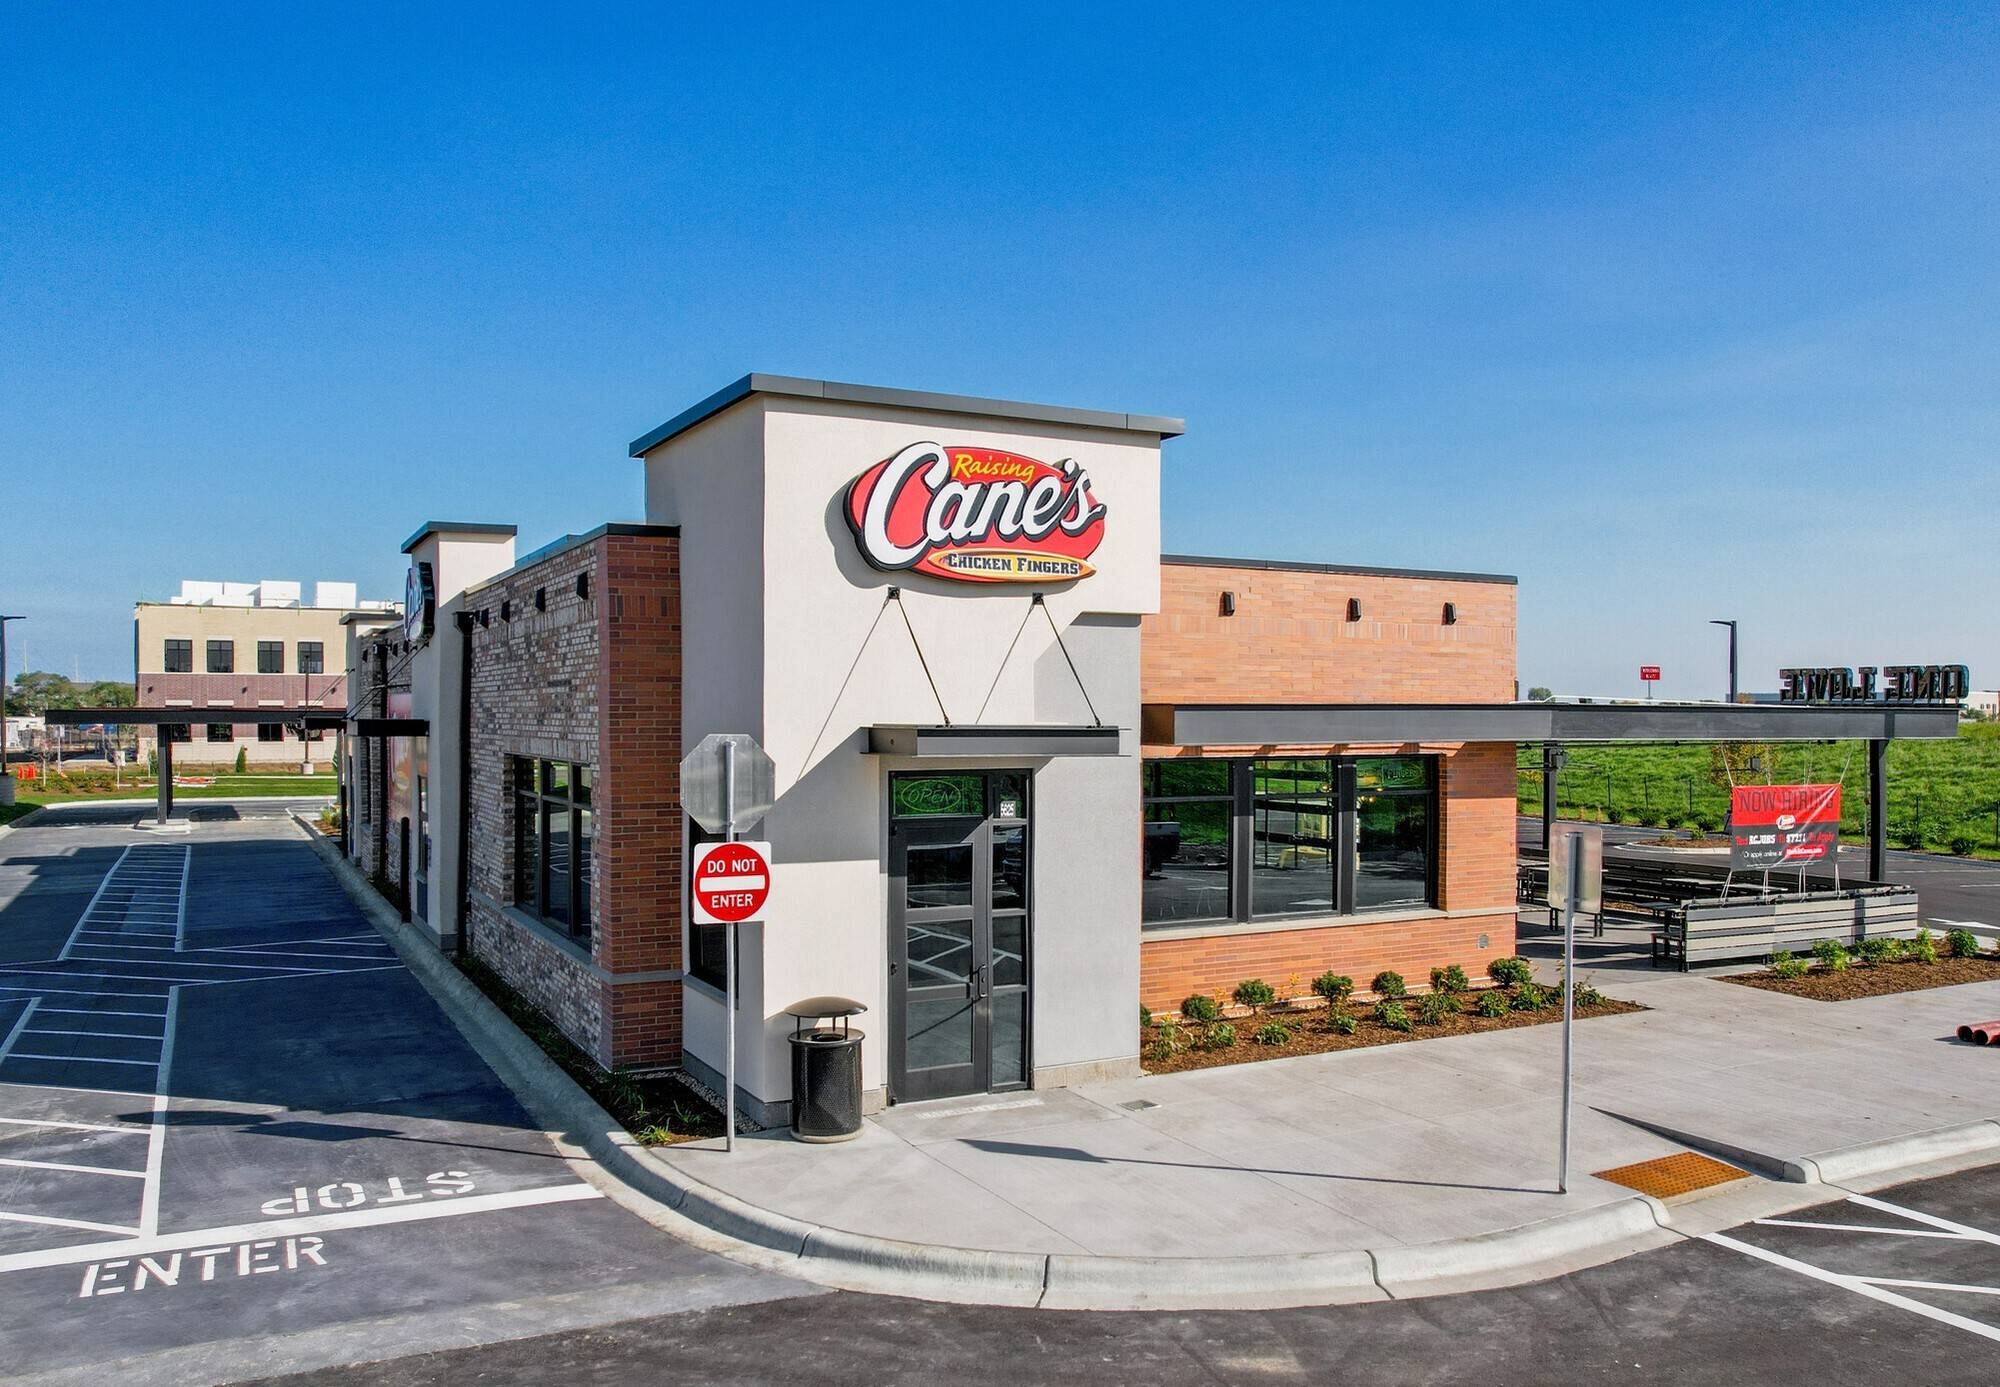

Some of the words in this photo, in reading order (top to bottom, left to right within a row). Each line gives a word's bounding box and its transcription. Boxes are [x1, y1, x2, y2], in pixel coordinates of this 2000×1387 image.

[953, 454, 1035, 484] Raising
[864, 441, 1107, 564] Cane's
[949, 553, 1014, 572] CHICKEN
[1016, 557, 1079, 575] FINGERS
[908, 788, 954, 803] OPEN
[1740, 791, 1775, 812] NOW
[1781, 790, 1833, 811] HIRING
[707, 860, 726, 874] DO
[731, 859, 758, 873] NOT
[711, 894, 754, 909] ENTER
[260, 1170, 478, 1216] STOP
[79, 1235, 328, 1298] ENTER
